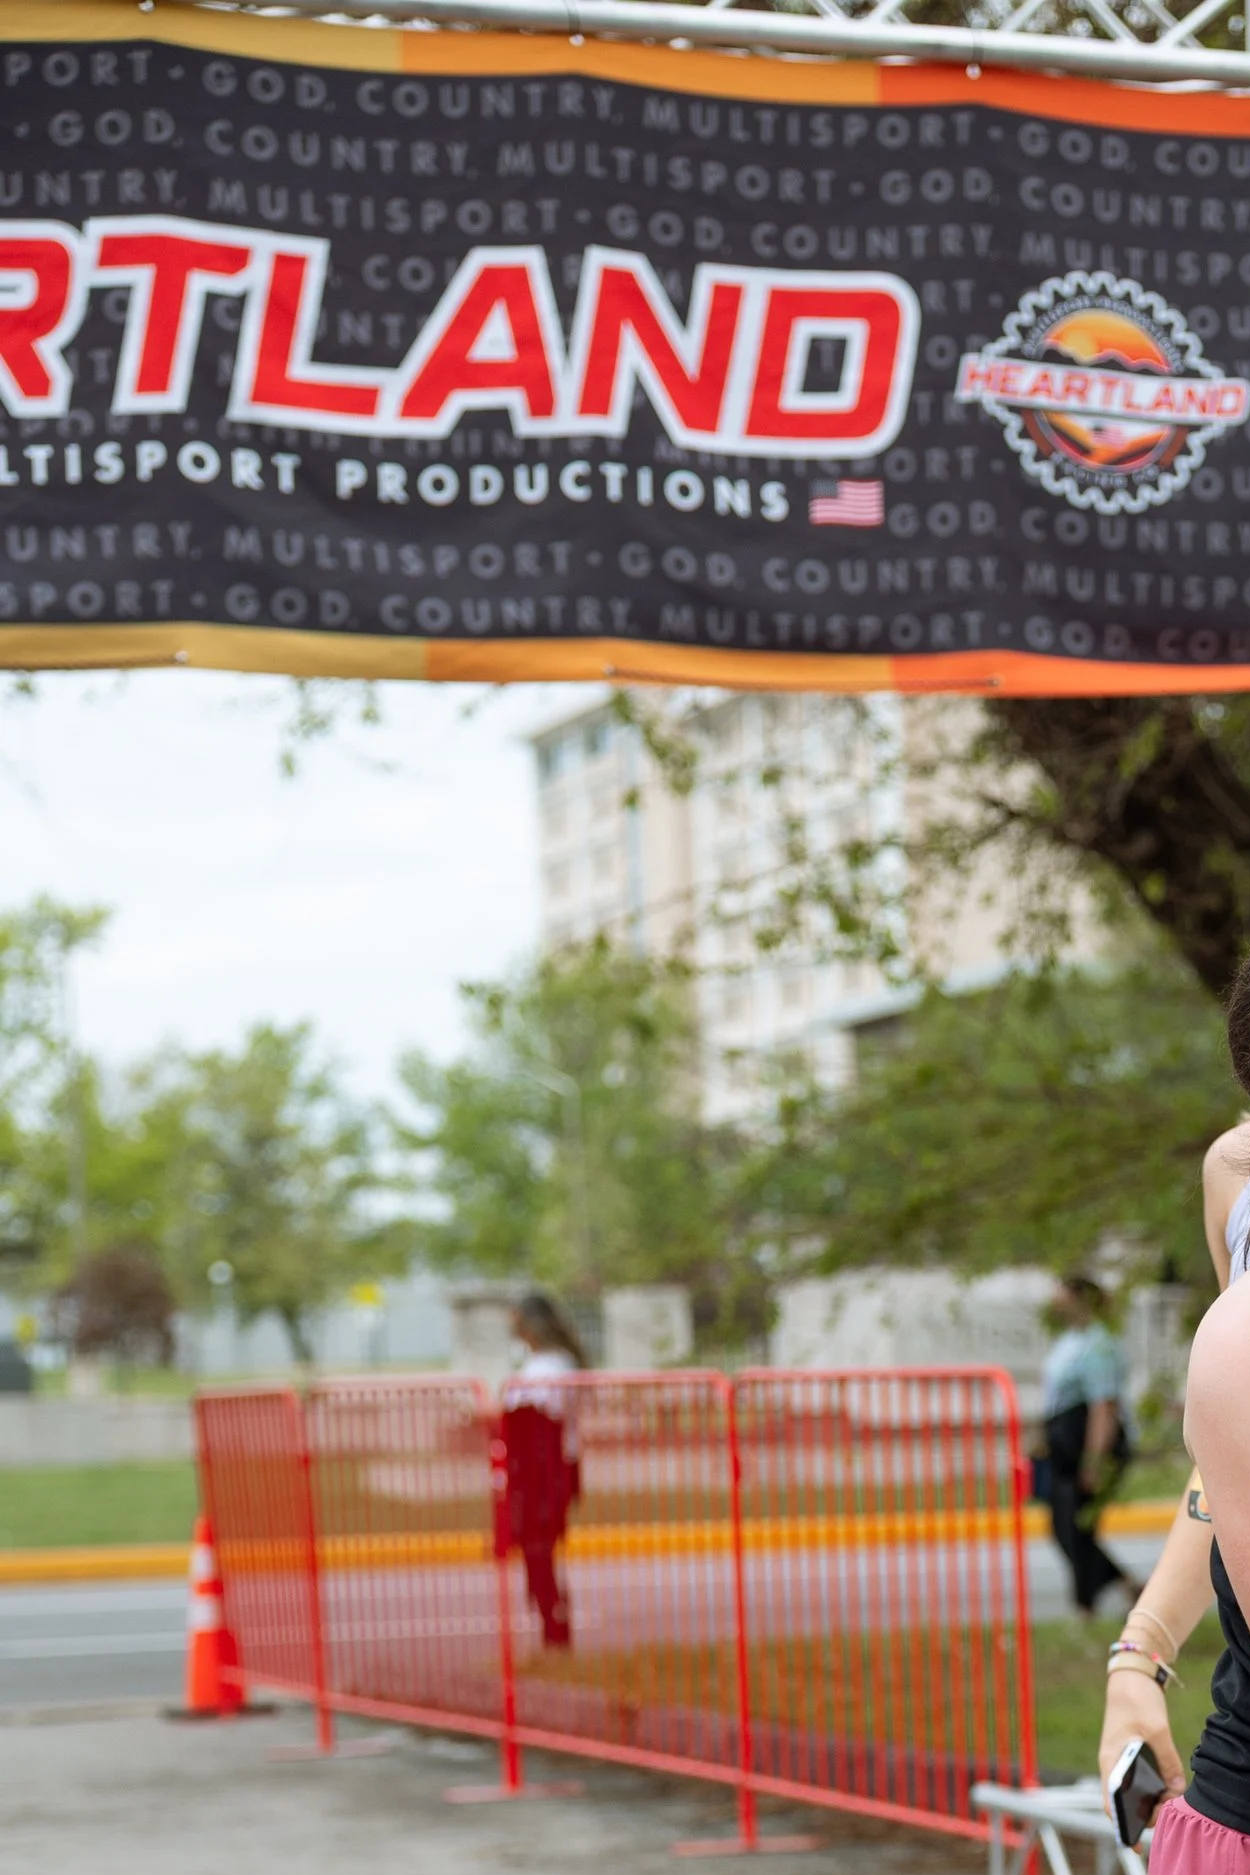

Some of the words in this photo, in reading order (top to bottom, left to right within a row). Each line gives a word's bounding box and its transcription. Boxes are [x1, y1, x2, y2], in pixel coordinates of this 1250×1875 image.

[641, 95, 977, 150] MULTISPORT
[496, 139, 838, 206] MULTISPORT
[206, 176, 562, 236] MULTISPORT
[960, 357, 1247, 419] HEARTLAND
[335, 457, 791, 523] PRODUCTIONS
[223, 524, 573, 580] MULTISPORT
[658, 602, 985, 650] MULTISPORT
